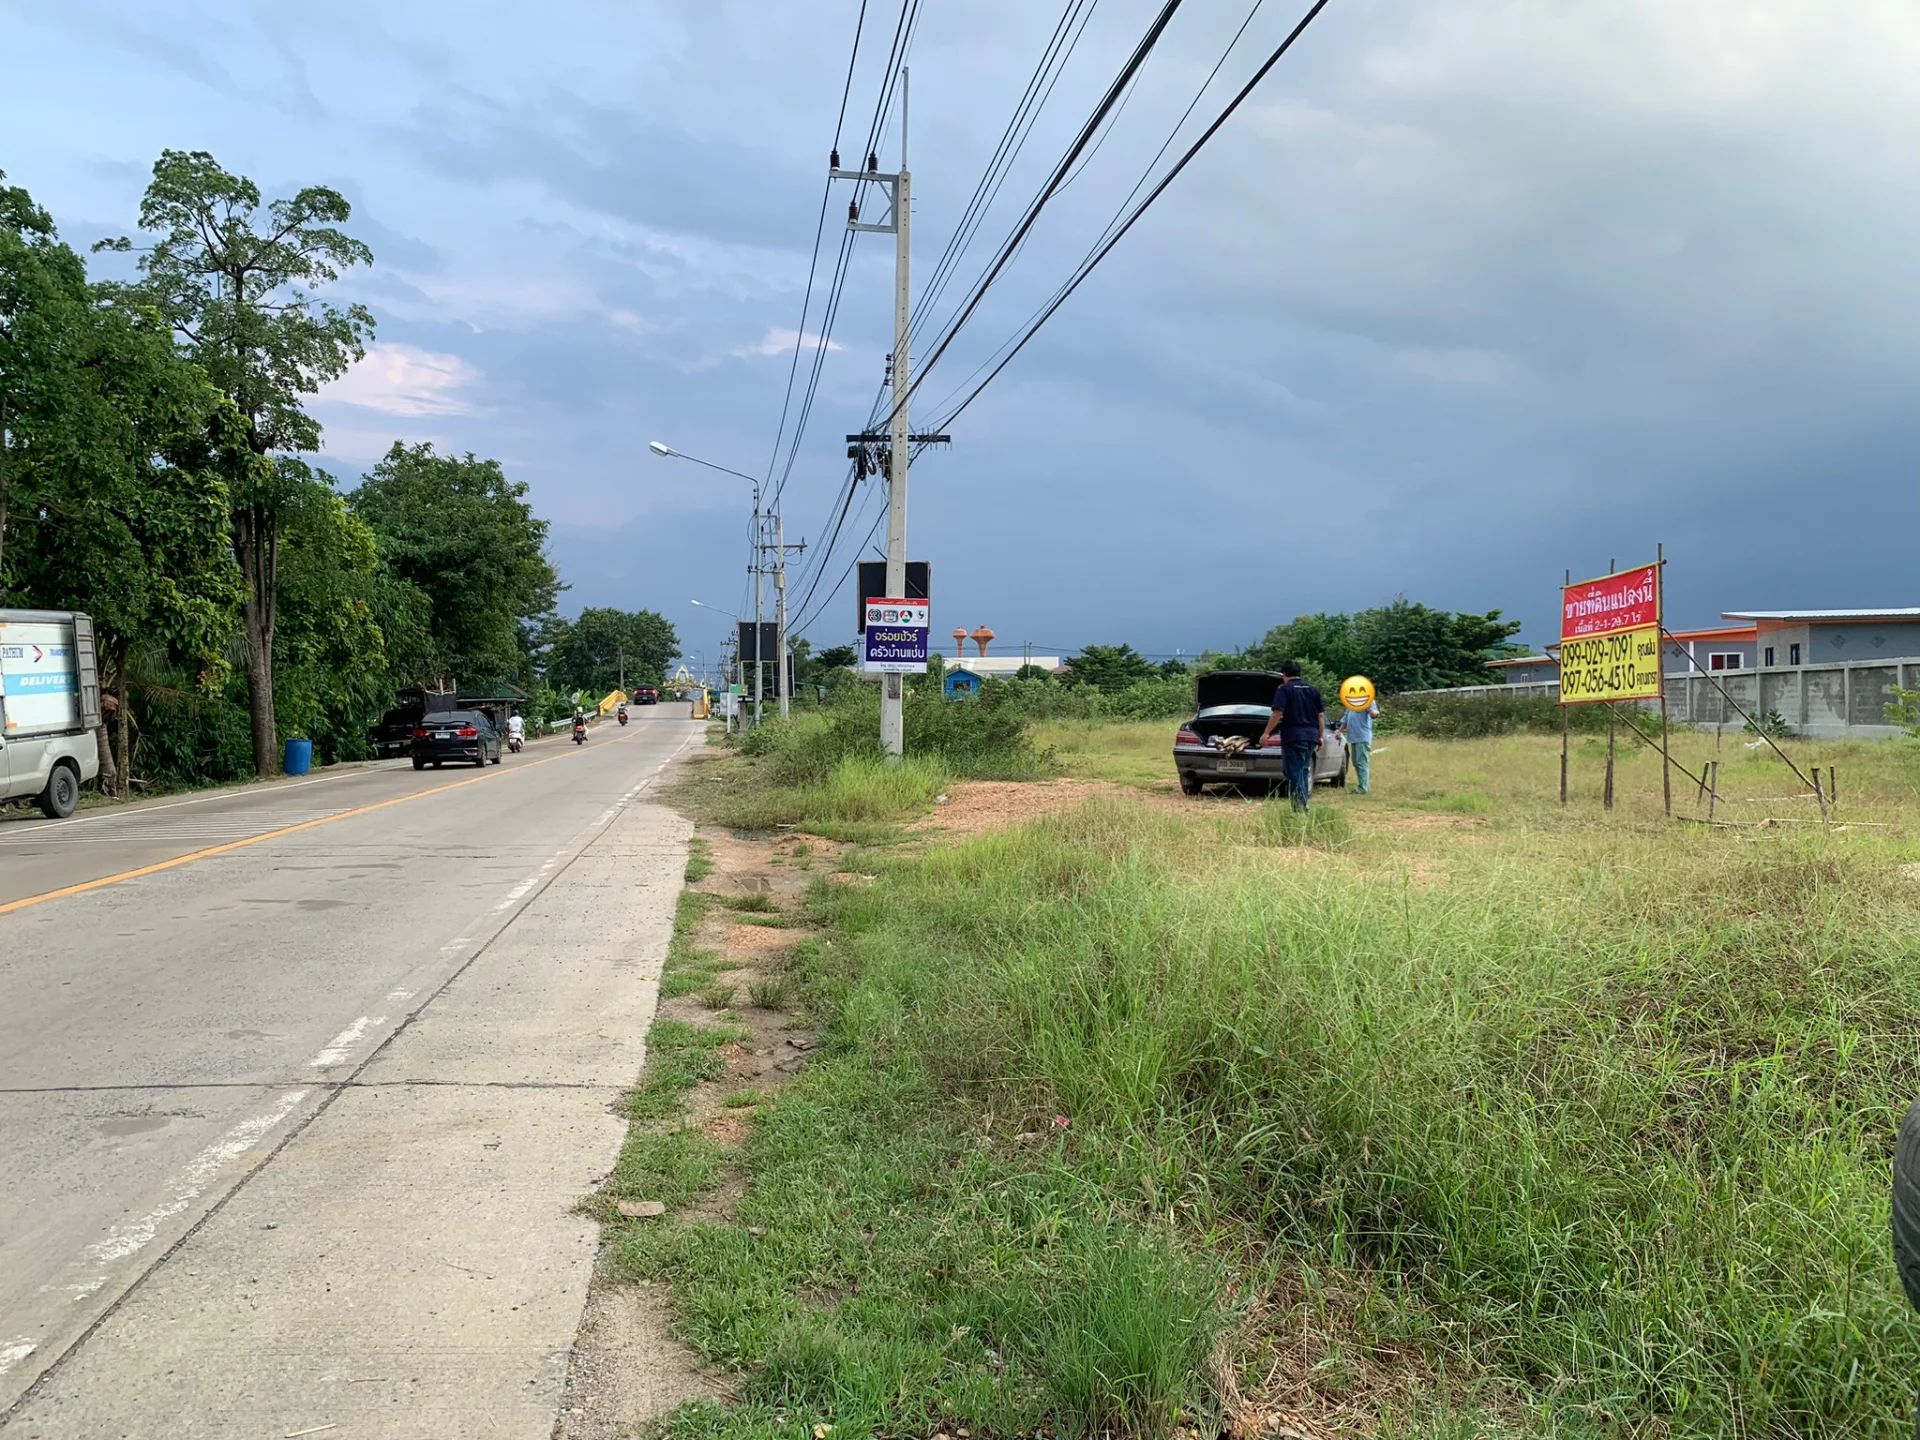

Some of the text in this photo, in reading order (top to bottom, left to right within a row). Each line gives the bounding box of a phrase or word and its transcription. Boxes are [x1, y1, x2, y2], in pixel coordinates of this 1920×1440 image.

[1565, 568, 1653, 619] ขายที่ดินแปลงนี้
[875, 628, 919, 642] อร่อยชัวร์
[1575, 619, 1593, 634] เนื้อที่
[1631, 611, 1641, 623] ไร่
[1562, 634, 1633, 668] 099-029-7091
[1562, 663, 1636, 695] 097-056-4510
